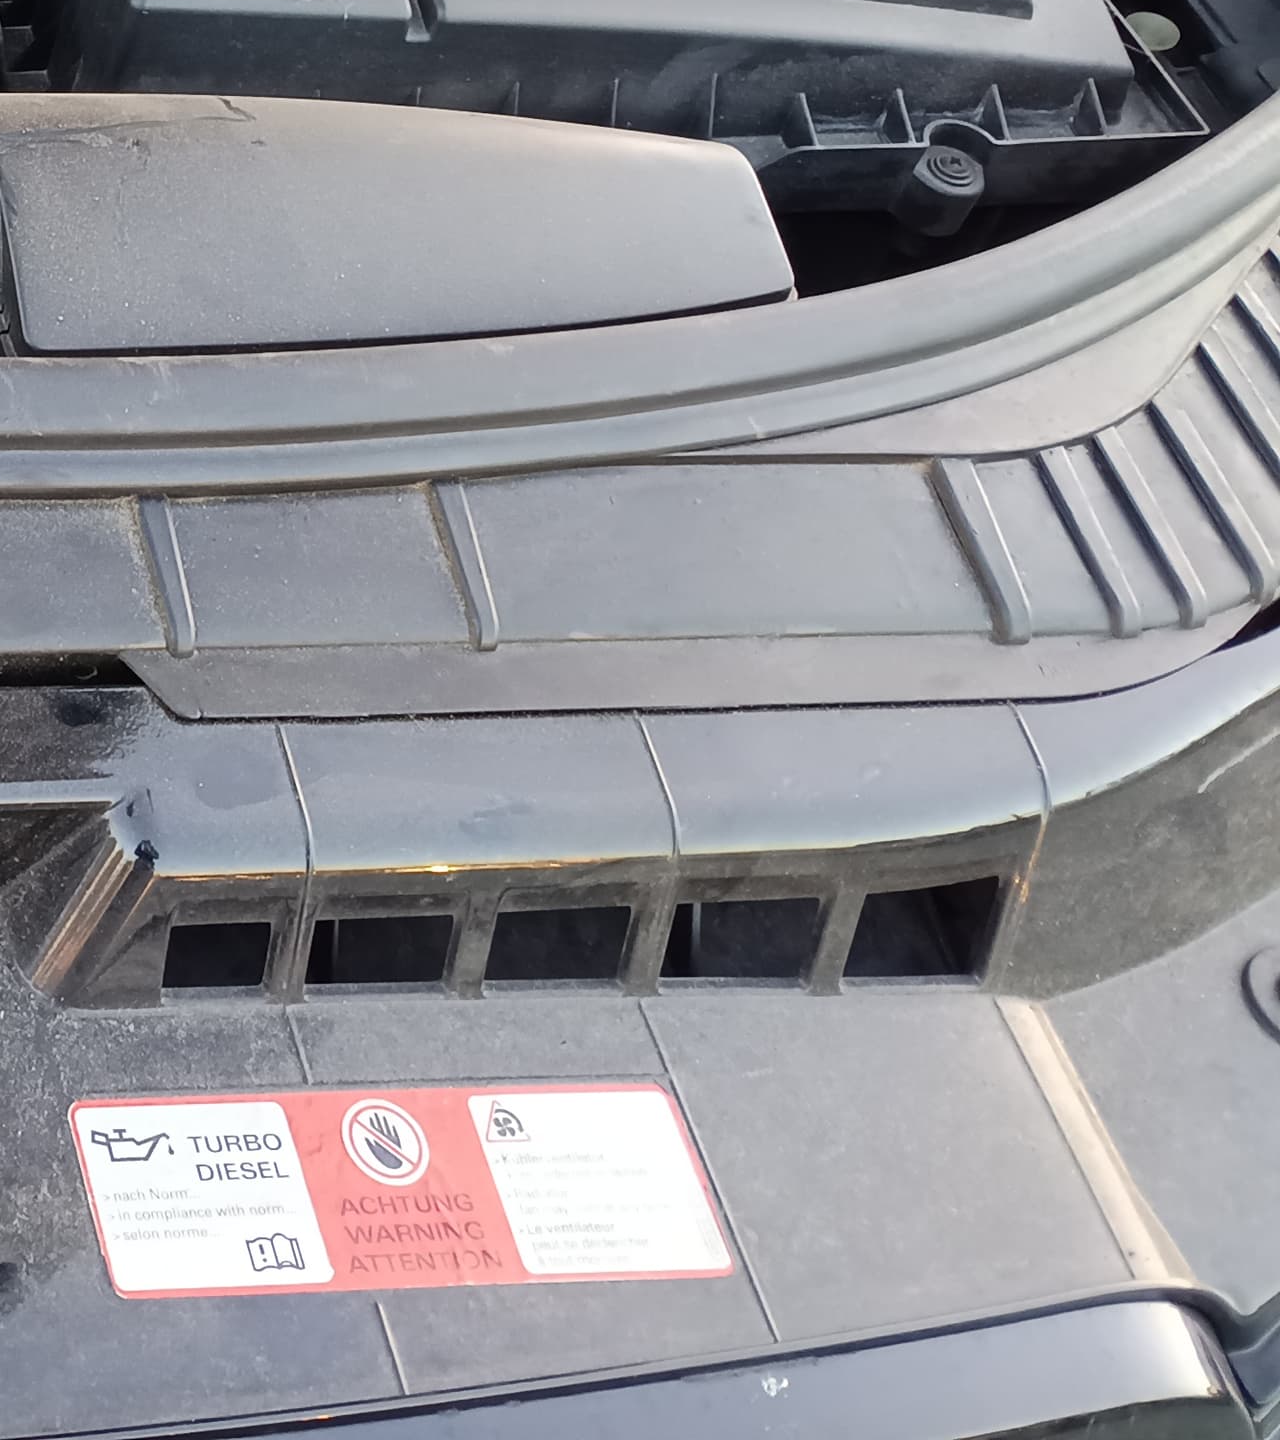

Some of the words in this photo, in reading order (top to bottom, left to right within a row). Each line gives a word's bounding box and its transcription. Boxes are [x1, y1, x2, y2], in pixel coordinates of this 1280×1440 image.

[187, 1132, 283, 1154] TURBO
[195, 1161, 290, 1182] DIESEL
[113, 1189, 146, 1202] nach
[340, 1192, 475, 1217] ACHTUNG
[134, 1205, 213, 1222] compliance
[215, 1204, 246, 1218] with
[122, 1229, 160, 1241] selon
[344, 1220, 486, 1245] WARNING
[349, 1249, 504, 1274] ATTENTION
